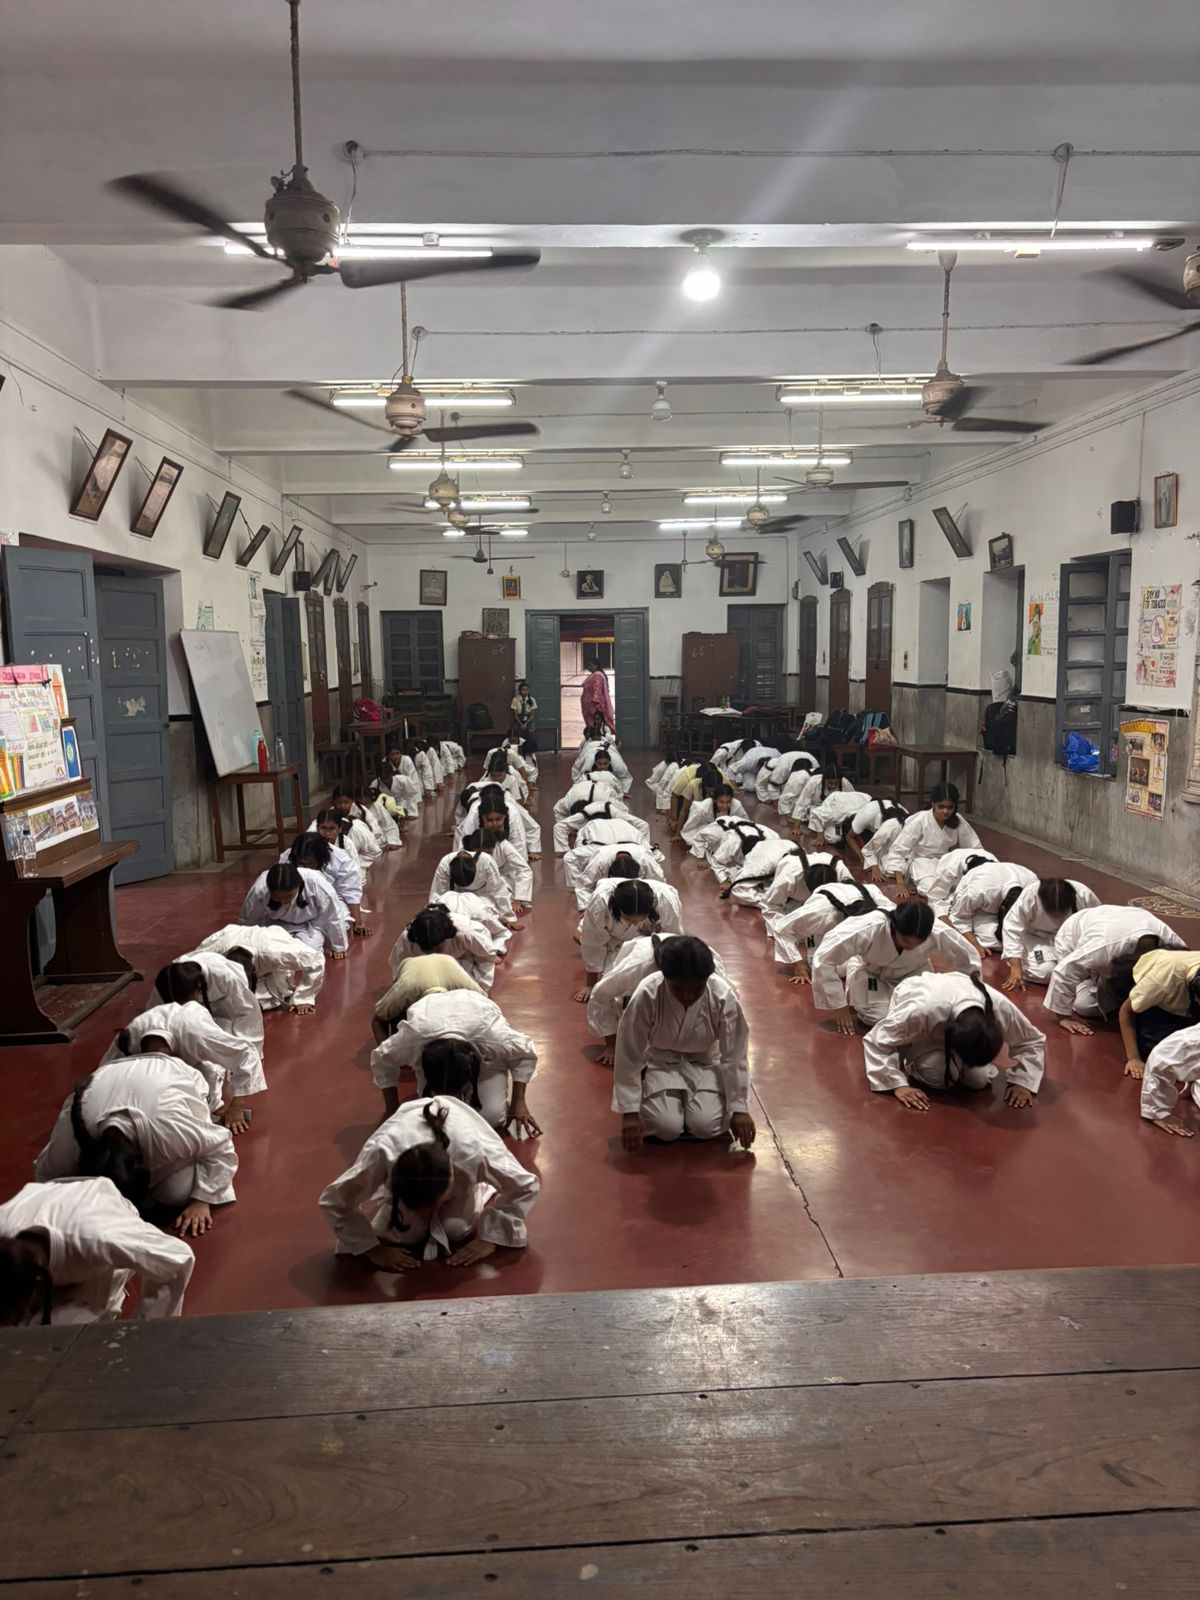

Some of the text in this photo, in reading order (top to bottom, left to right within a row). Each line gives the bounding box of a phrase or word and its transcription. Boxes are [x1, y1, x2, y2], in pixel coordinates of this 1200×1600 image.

[1146, 590, 1160, 600] SAY NO
[1151, 600, 1166, 608] TOBACCO
